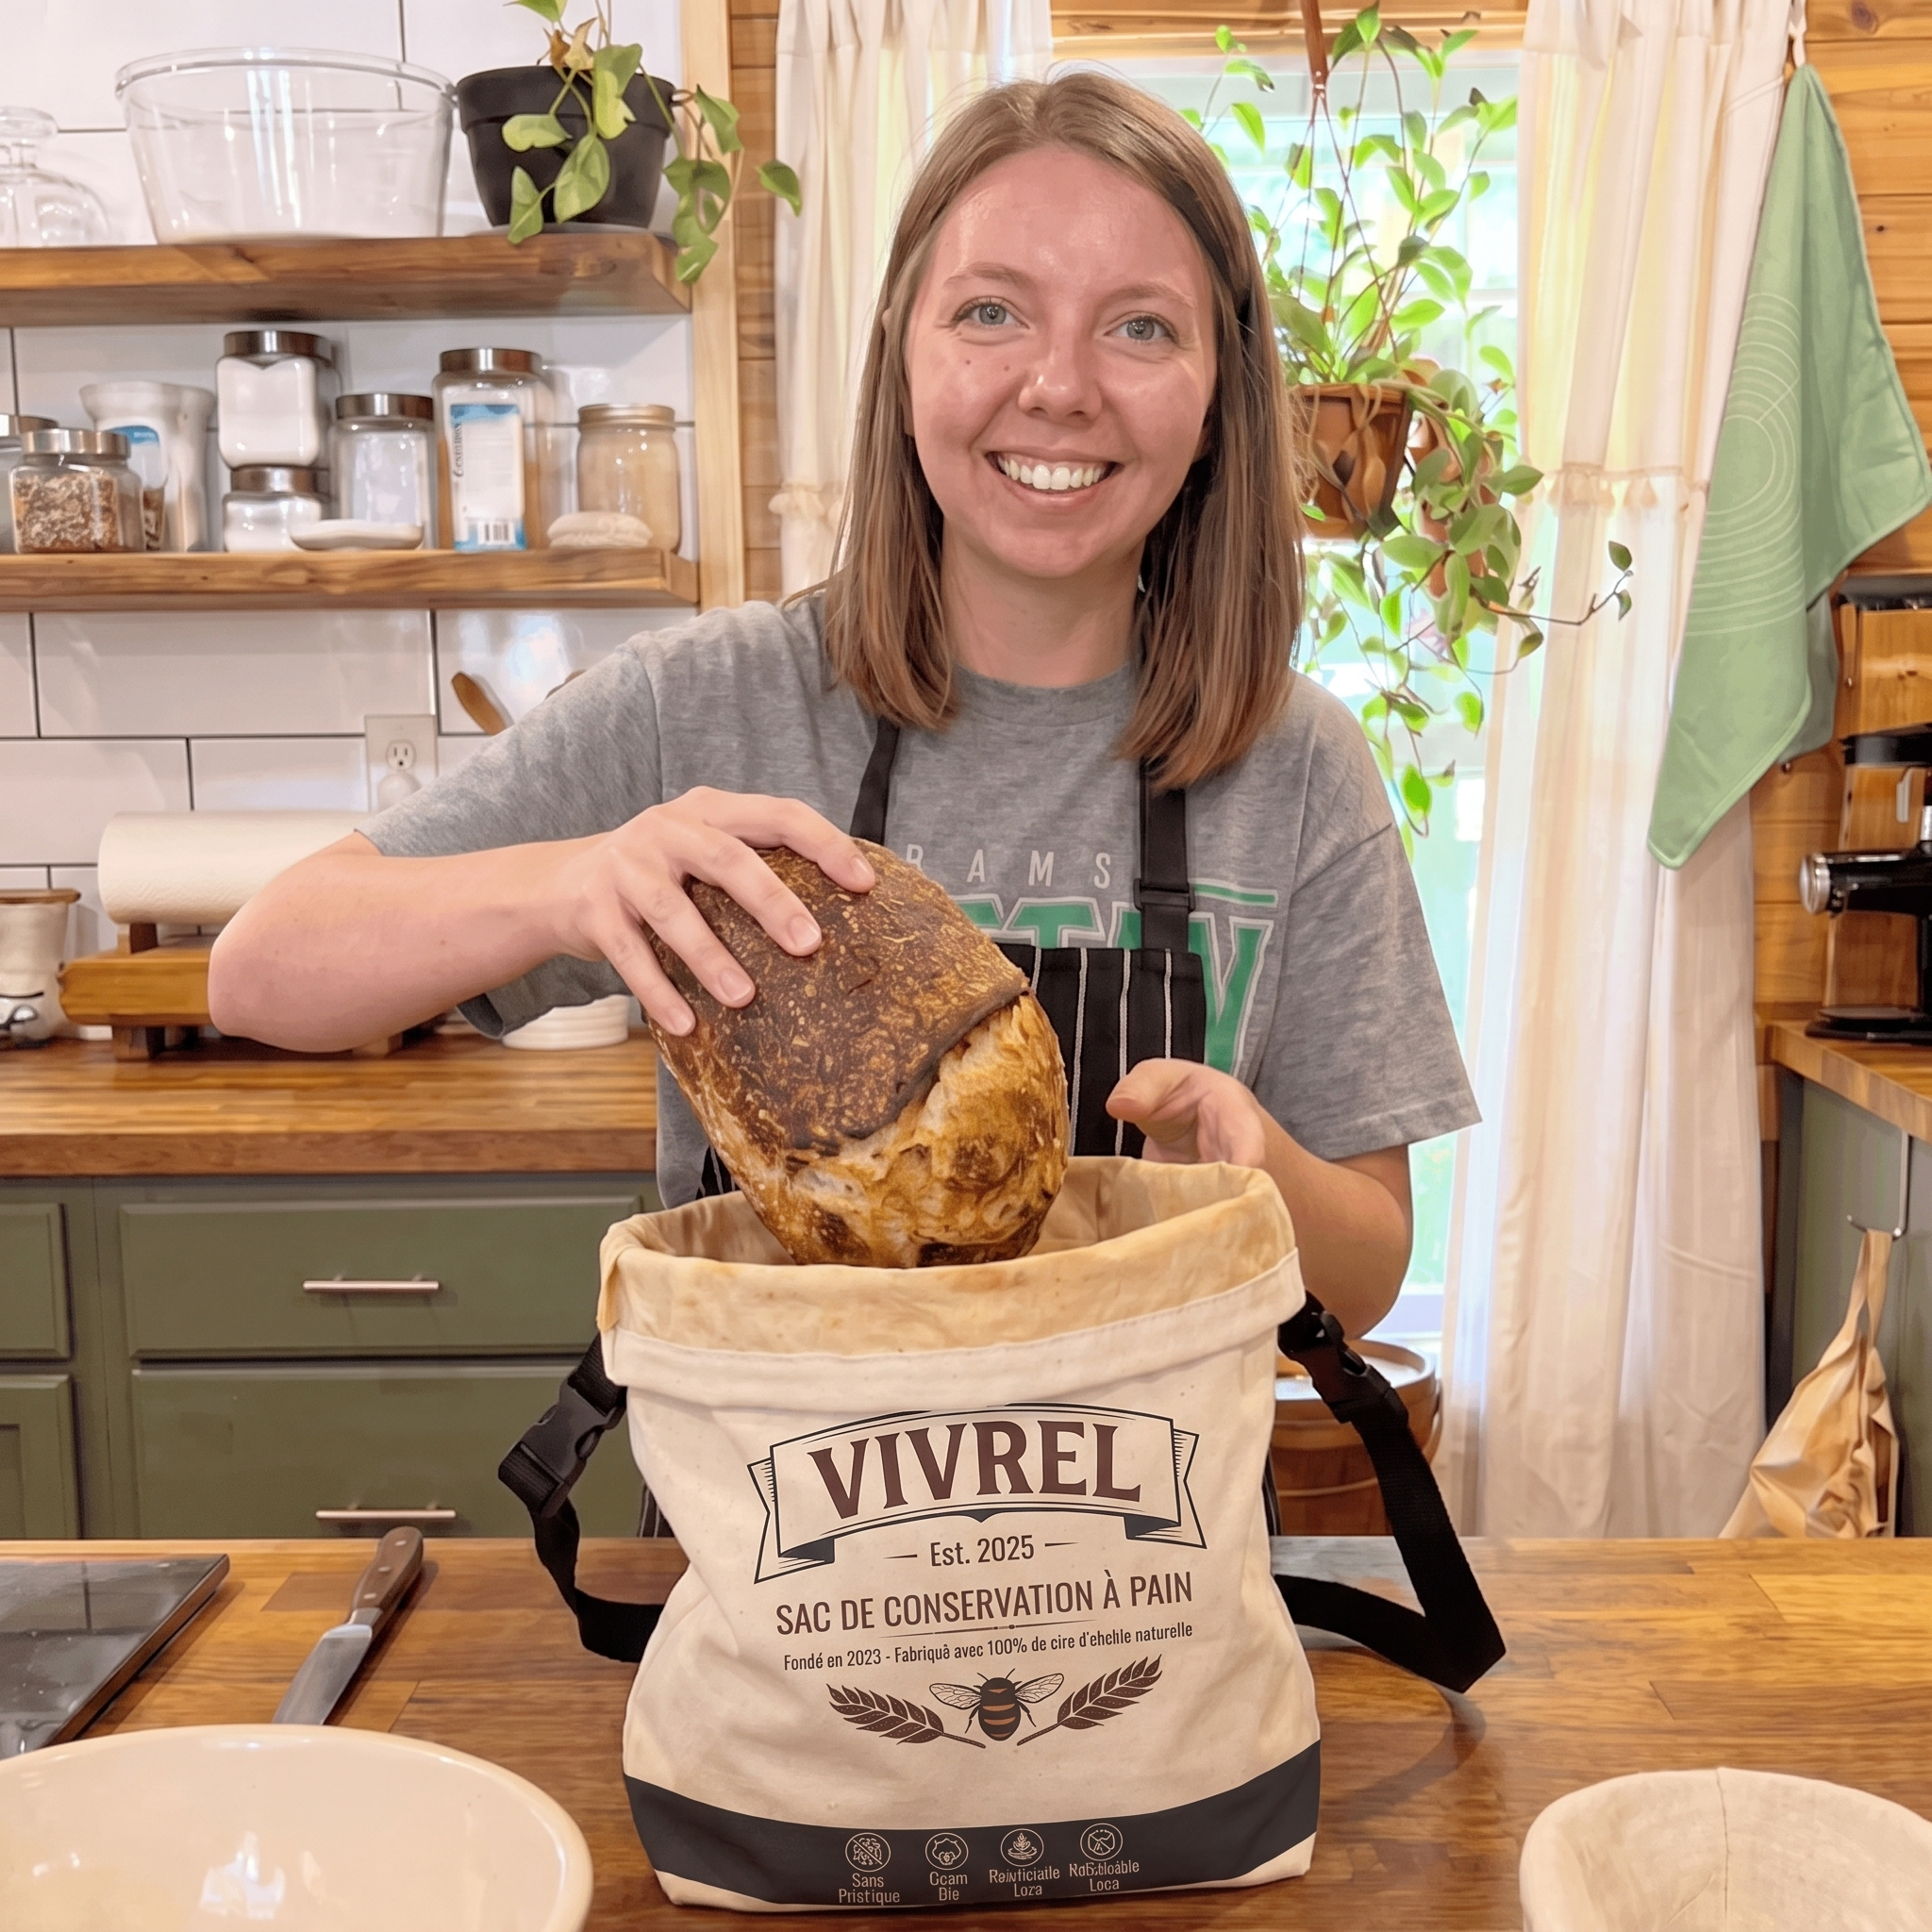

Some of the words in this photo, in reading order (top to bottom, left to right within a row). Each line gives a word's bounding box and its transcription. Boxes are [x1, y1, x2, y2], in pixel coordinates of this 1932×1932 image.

[906, 843, 1111, 889] RAMS
[807, 1420, 1141, 1520] VIVREL
[930, 1541, 971, 1567] Est.
[976, 1534, 1035, 1564] 2025
[776, 1601, 830, 1635] SAC
[841, 1598, 874, 1630] DE
[884, 1580, 1092, 1627] CONSERVATION
[1103, 1570, 1121, 1608] À
[1130, 1572, 1192, 1607] PAIN
[784, 1653, 823, 1671] Fondé
[827, 1655, 842, 1668] en
[847, 1649, 881, 1667] 2023
[954, 1644, 983, 1658] avec
[987, 1637, 1027, 1656] 100%
[1031, 1636, 1047, 1652] de
[1051, 1634, 1074, 1650] cire
[1135, 1622, 1192, 1642] naturelle
[839, 1888, 900, 1906] Pristique
[852, 1873, 885, 1888] Sans
[939, 1887, 959, 1901] Bie
[1090, 1878, 1120, 1892] Loca
